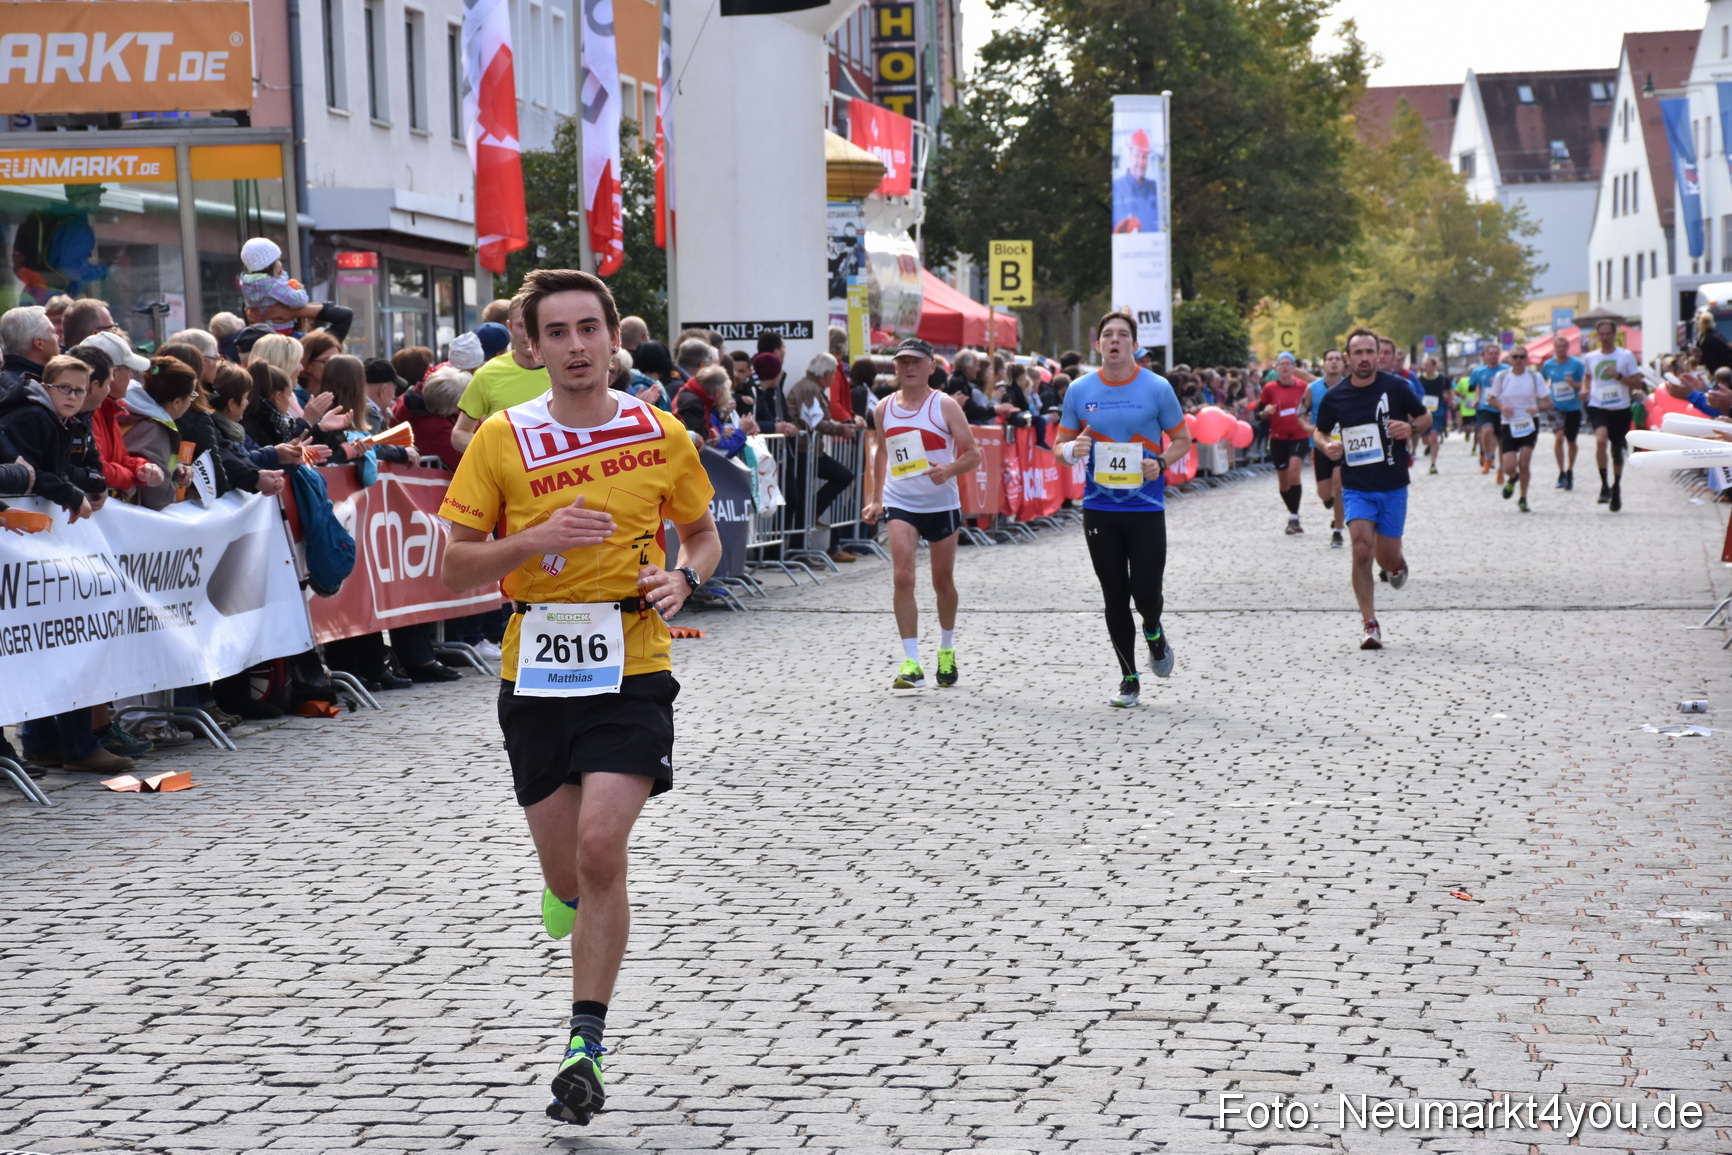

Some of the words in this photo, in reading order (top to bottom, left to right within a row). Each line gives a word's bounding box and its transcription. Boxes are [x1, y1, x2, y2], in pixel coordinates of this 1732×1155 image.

[994, 243, 1027, 255] Block
[1001, 261, 1021, 291] B
[1281, 330, 1293, 348] C
[1348, 436, 1374, 451] 2347
[895, 447, 909, 462] 61
[1110, 457, 1126, 471] 44
[529, 465, 594, 498] MAX
[601, 449, 667, 478] BÖGL
[556, 613, 591, 621] BOCK
[535, 634, 608, 663] 2616
[547, 673, 593, 683] Matthias
